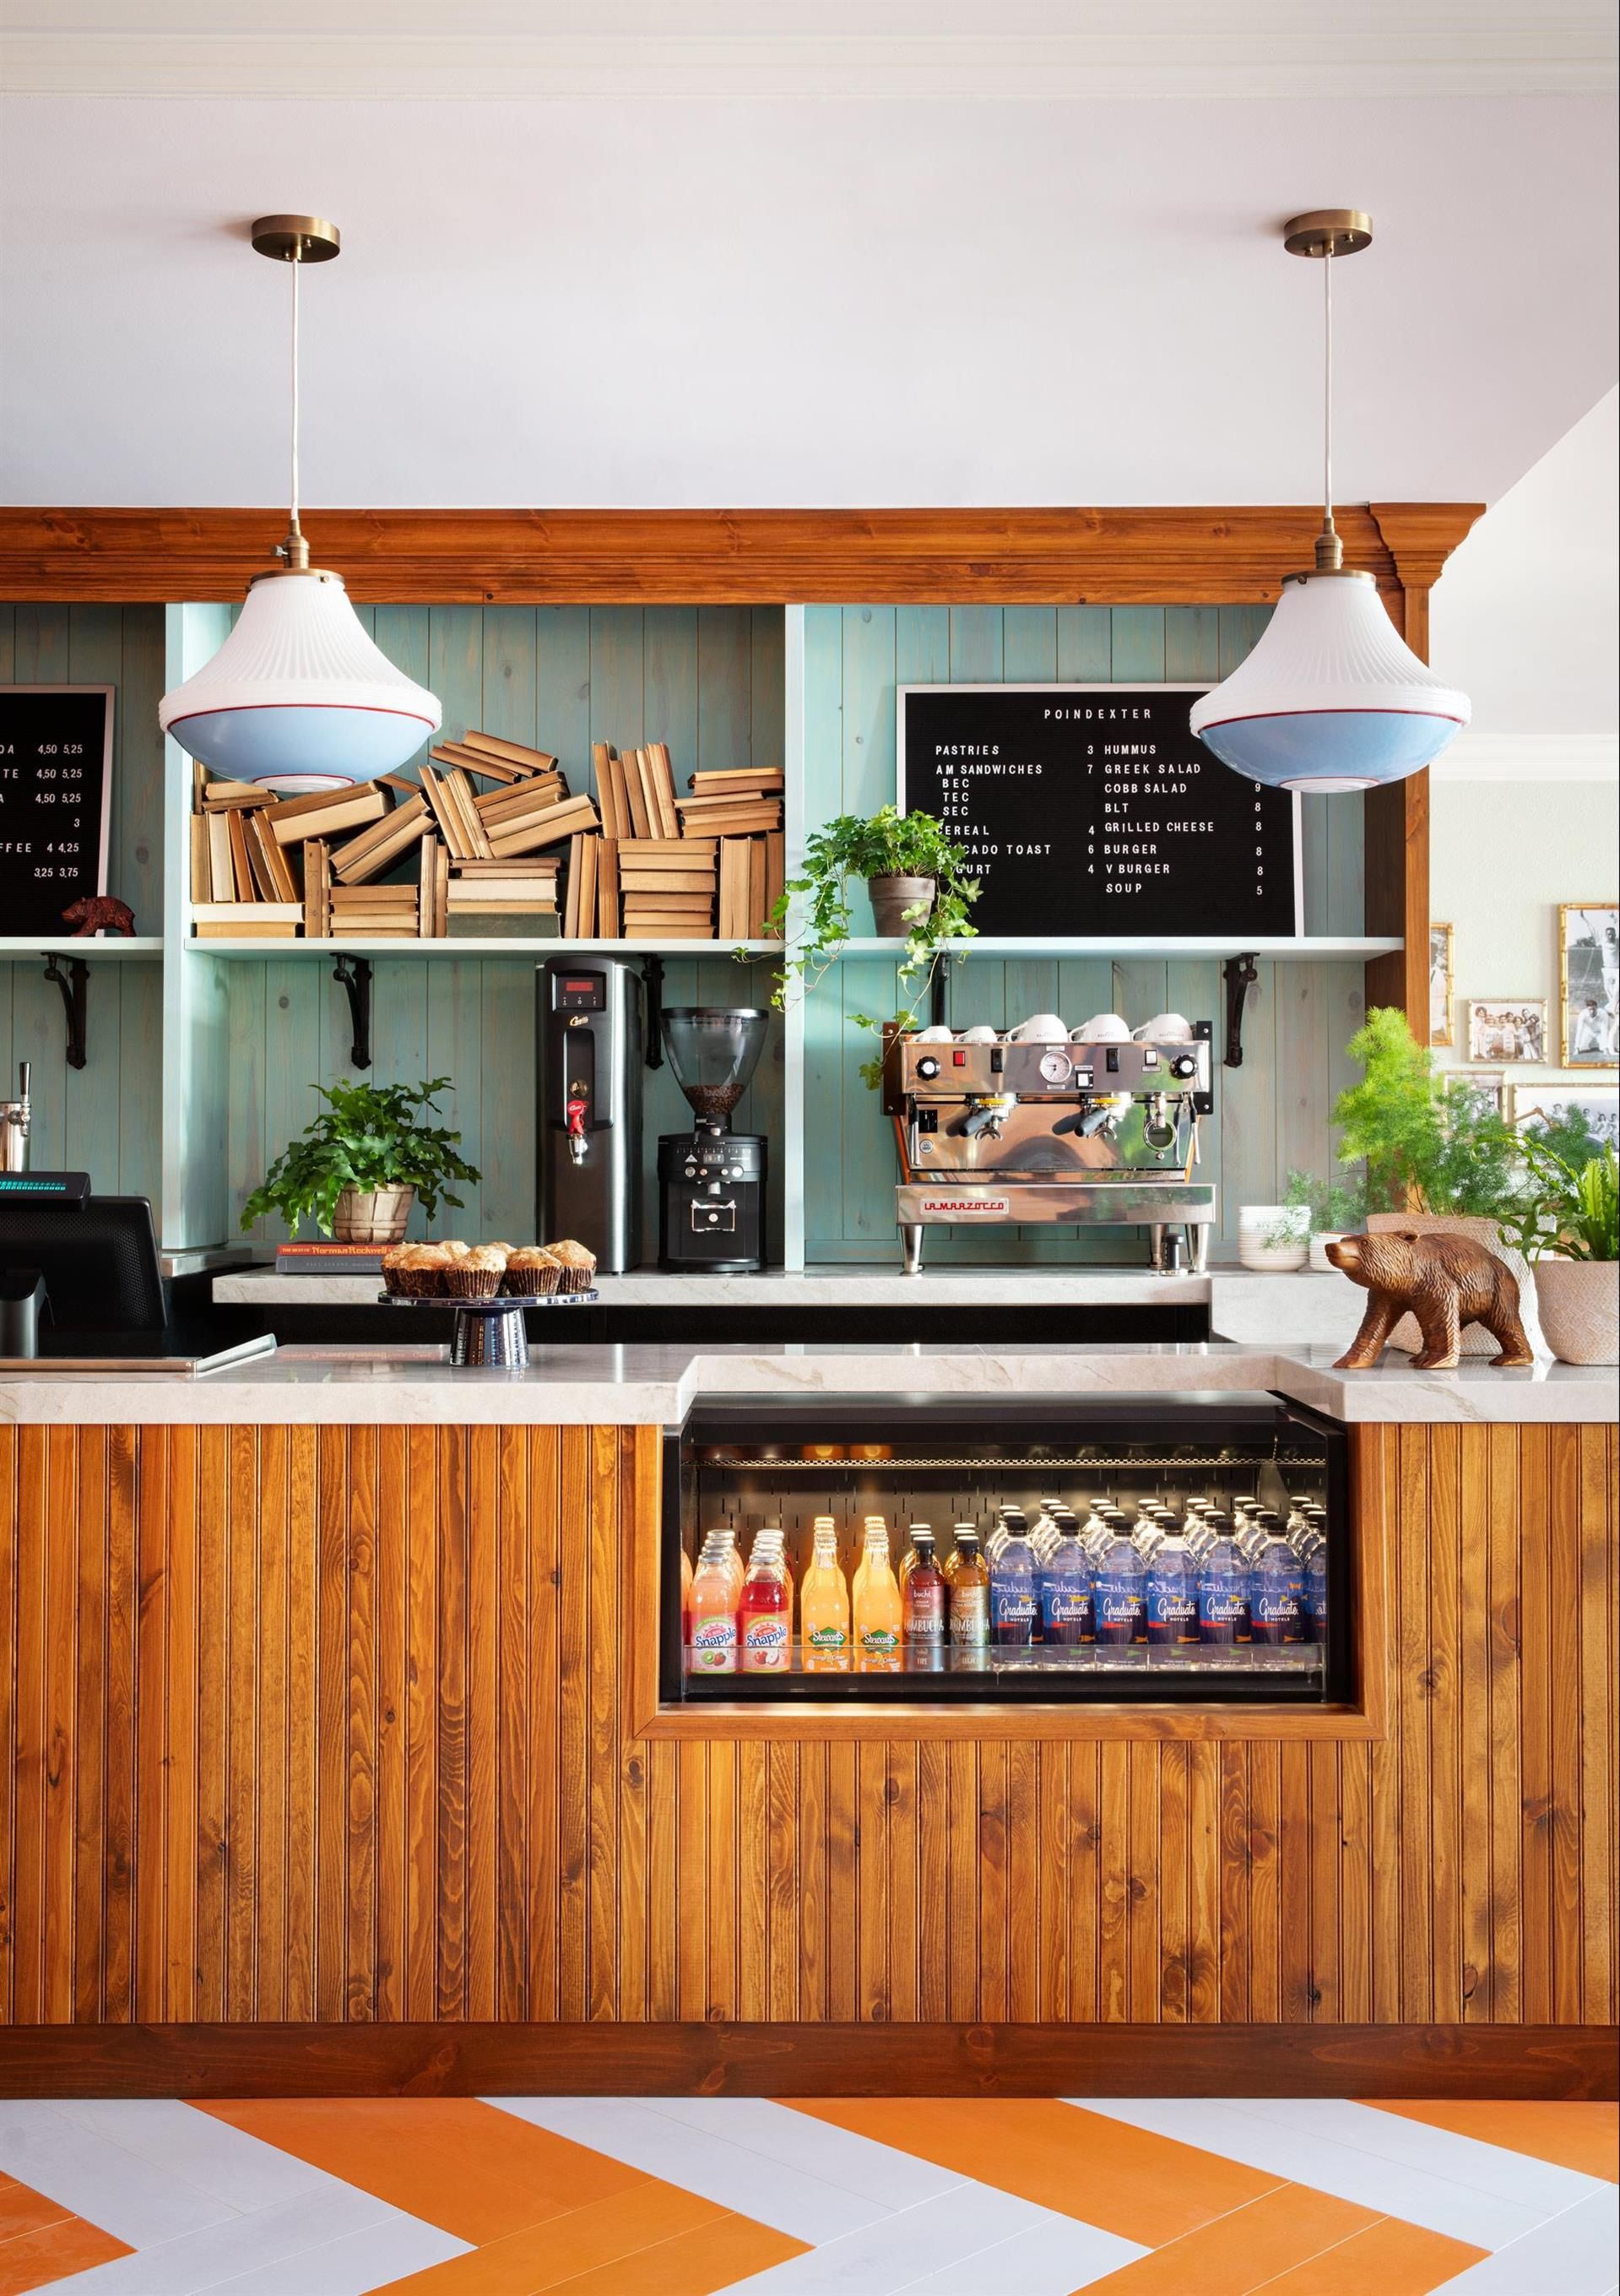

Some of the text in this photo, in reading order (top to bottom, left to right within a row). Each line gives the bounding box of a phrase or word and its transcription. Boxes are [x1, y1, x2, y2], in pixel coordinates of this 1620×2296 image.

[1043, 708, 1151, 720] POINDEXTER
[37, 744, 57, 755] 4.50
[62, 744, 83, 755] 5.25
[935, 745, 1094, 756] PASTRIES 3
[1104, 744, 1157, 755] HUMMUS
[3, 768, 83, 779] TE 4.50 5.25
[935, 763, 1093, 775] AM SANDWICHES 7
[1104, 763, 1201, 774] GREEK SALAD
[941, 778, 970, 789] BEC
[1104, 783, 1261, 794] COBB SALAD 9
[35, 793, 56, 804] 4.50
[62, 793, 81, 804] 5.25
[942, 791, 969, 803] TEC
[942, 806, 969, 817] SEC
[1104, 801, 1261, 813] BLT 8
[73, 817, 80, 828] 3
[1104, 821, 1262, 833] GRILLED CHEESE 8
[1088, 825, 1095, 836] 4
[46, 843, 53, 853] 4
[57, 843, 79, 854] 4.25
[1005, 844, 1051, 855] TOAST
[1087, 844, 1095, 855] 6
[1103, 844, 1263, 856] BURGER 8
[34, 867, 79, 878] 3.25 3.75
[936, 863, 1095, 875] GURT 4
[1105, 863, 1264, 877] V BURGER 8
[1105, 882, 1263, 896] SOUP 5
[696, 1627, 736, 1649] Snapple
[747, 1626, 787, 1647] Snapple
